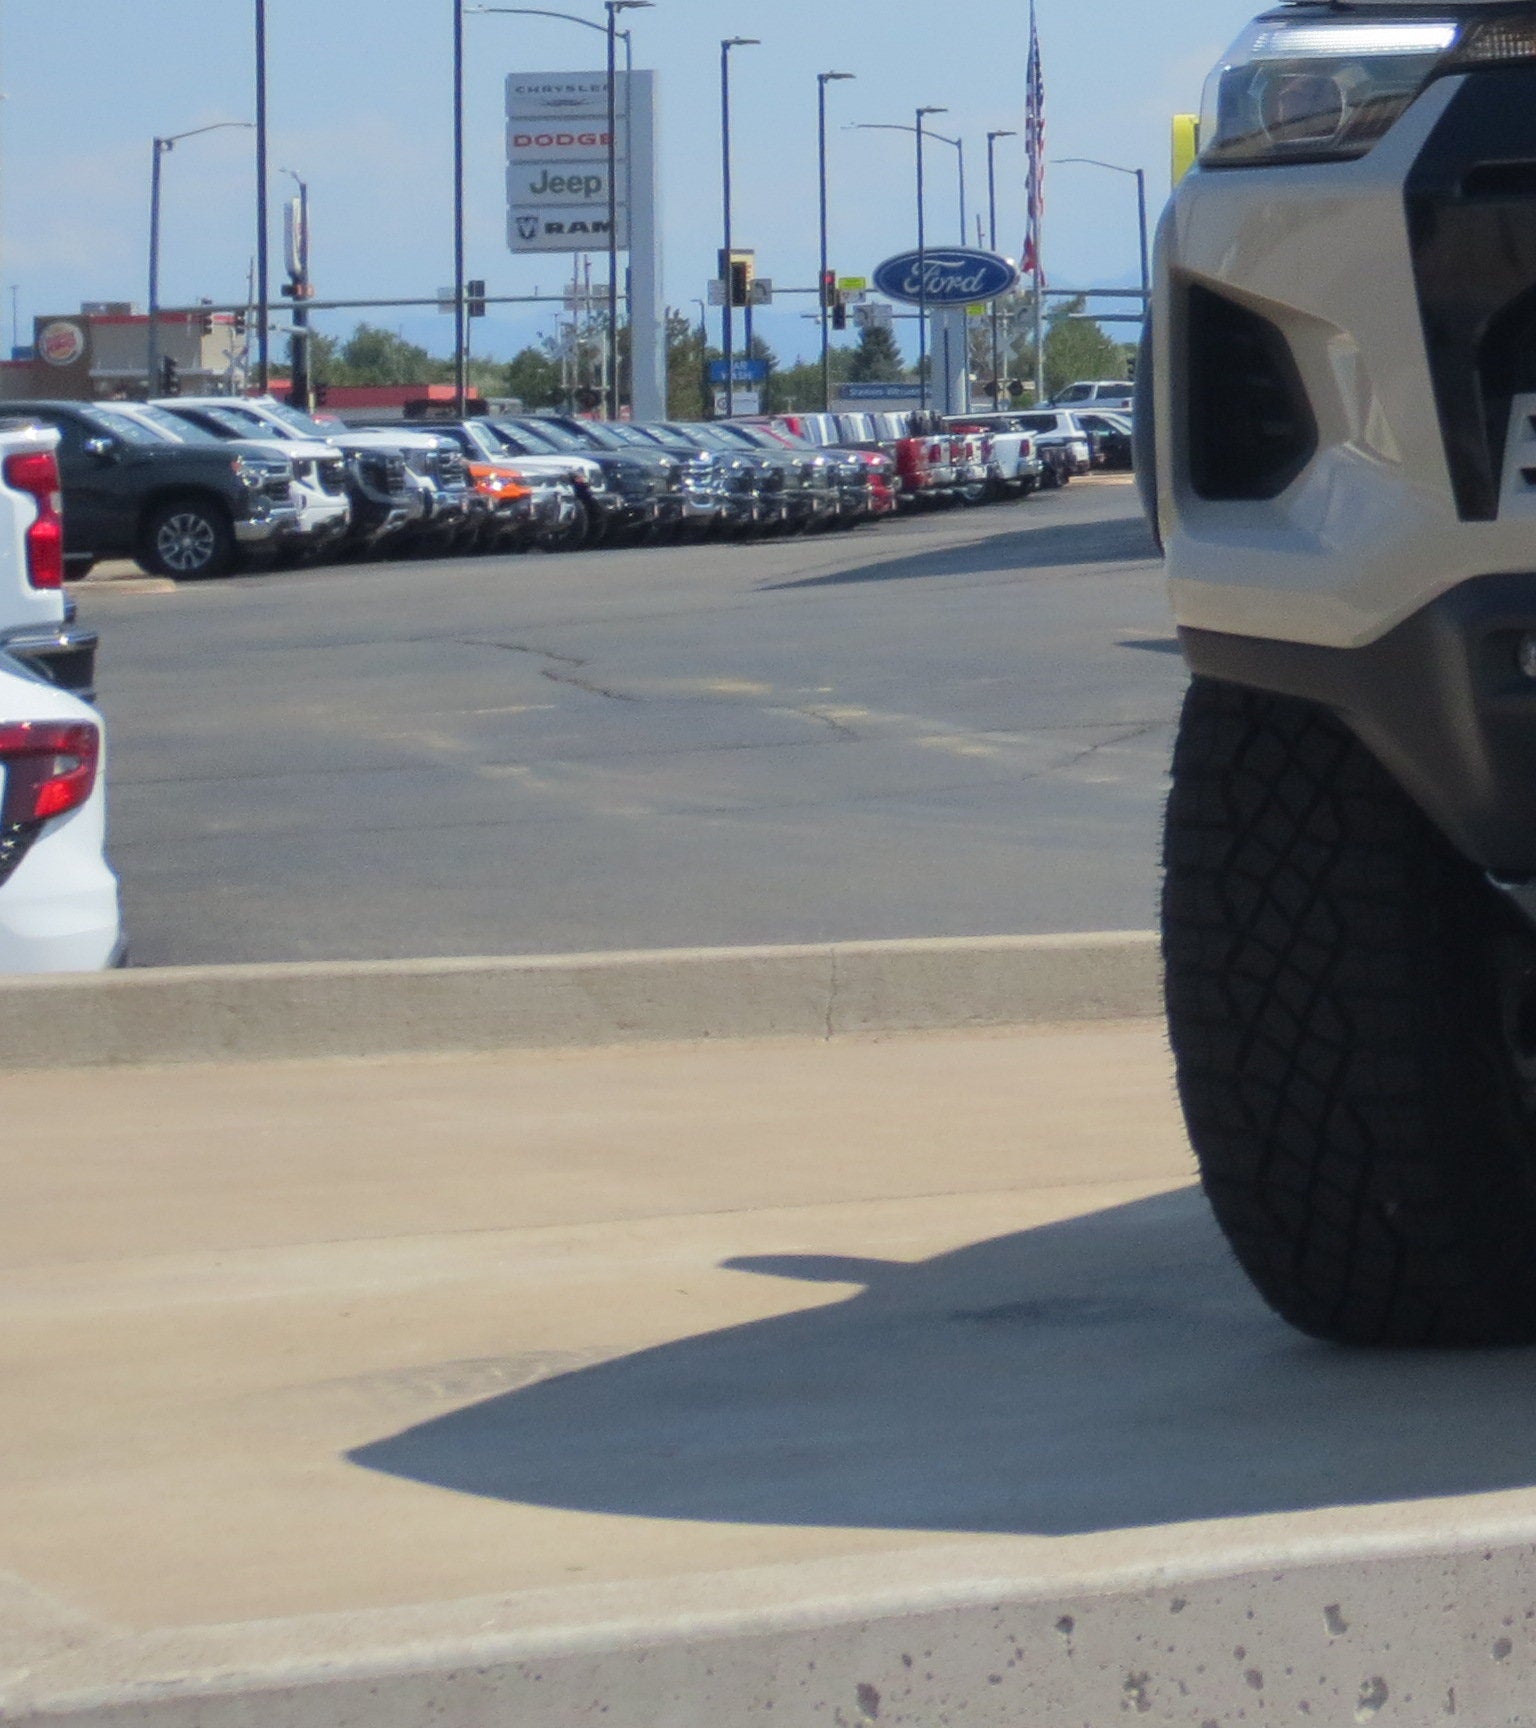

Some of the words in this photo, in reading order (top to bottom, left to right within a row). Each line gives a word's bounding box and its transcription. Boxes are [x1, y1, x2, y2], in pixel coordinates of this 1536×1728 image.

[529, 170, 602, 197] Jeep
[544, 221, 615, 234] RAM
[904, 259, 987, 293] Ford
